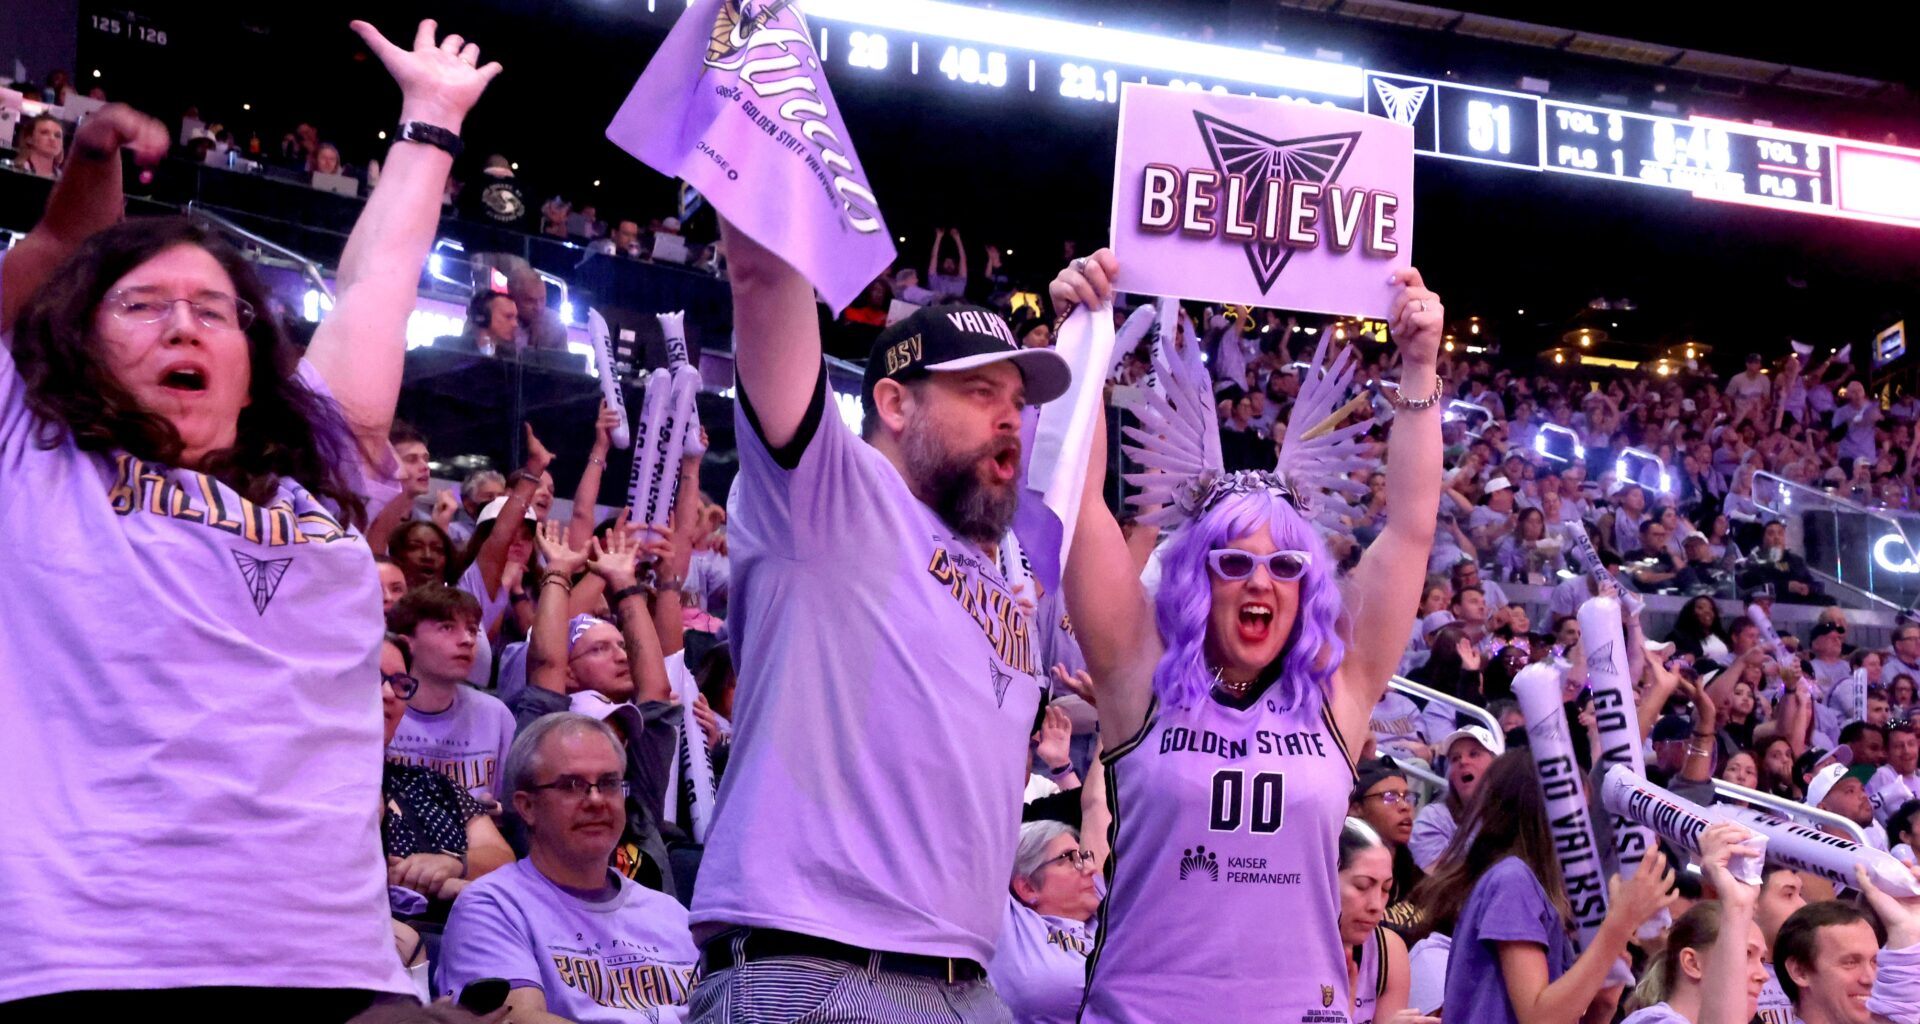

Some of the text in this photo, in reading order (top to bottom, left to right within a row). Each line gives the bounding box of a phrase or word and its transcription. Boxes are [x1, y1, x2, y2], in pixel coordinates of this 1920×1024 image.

[92, 15, 168, 45] 125 126
[742, 100, 779, 137] GOLDEN
[776, 130, 807, 156] STATE
[696, 141, 730, 171] CHASE
[1138, 163, 1399, 257] BELIEVE
[884, 334, 922, 376] GSV
[1593, 687, 1627, 733] GO
[1159, 727, 1327, 759] GOLDEN STATE
[1209, 768, 1285, 834] 00
[1227, 857, 1267, 869] KAISER
[1538, 756, 1606, 929] GO VALKS!
[1227, 872, 1301, 885] PERMANENTE
